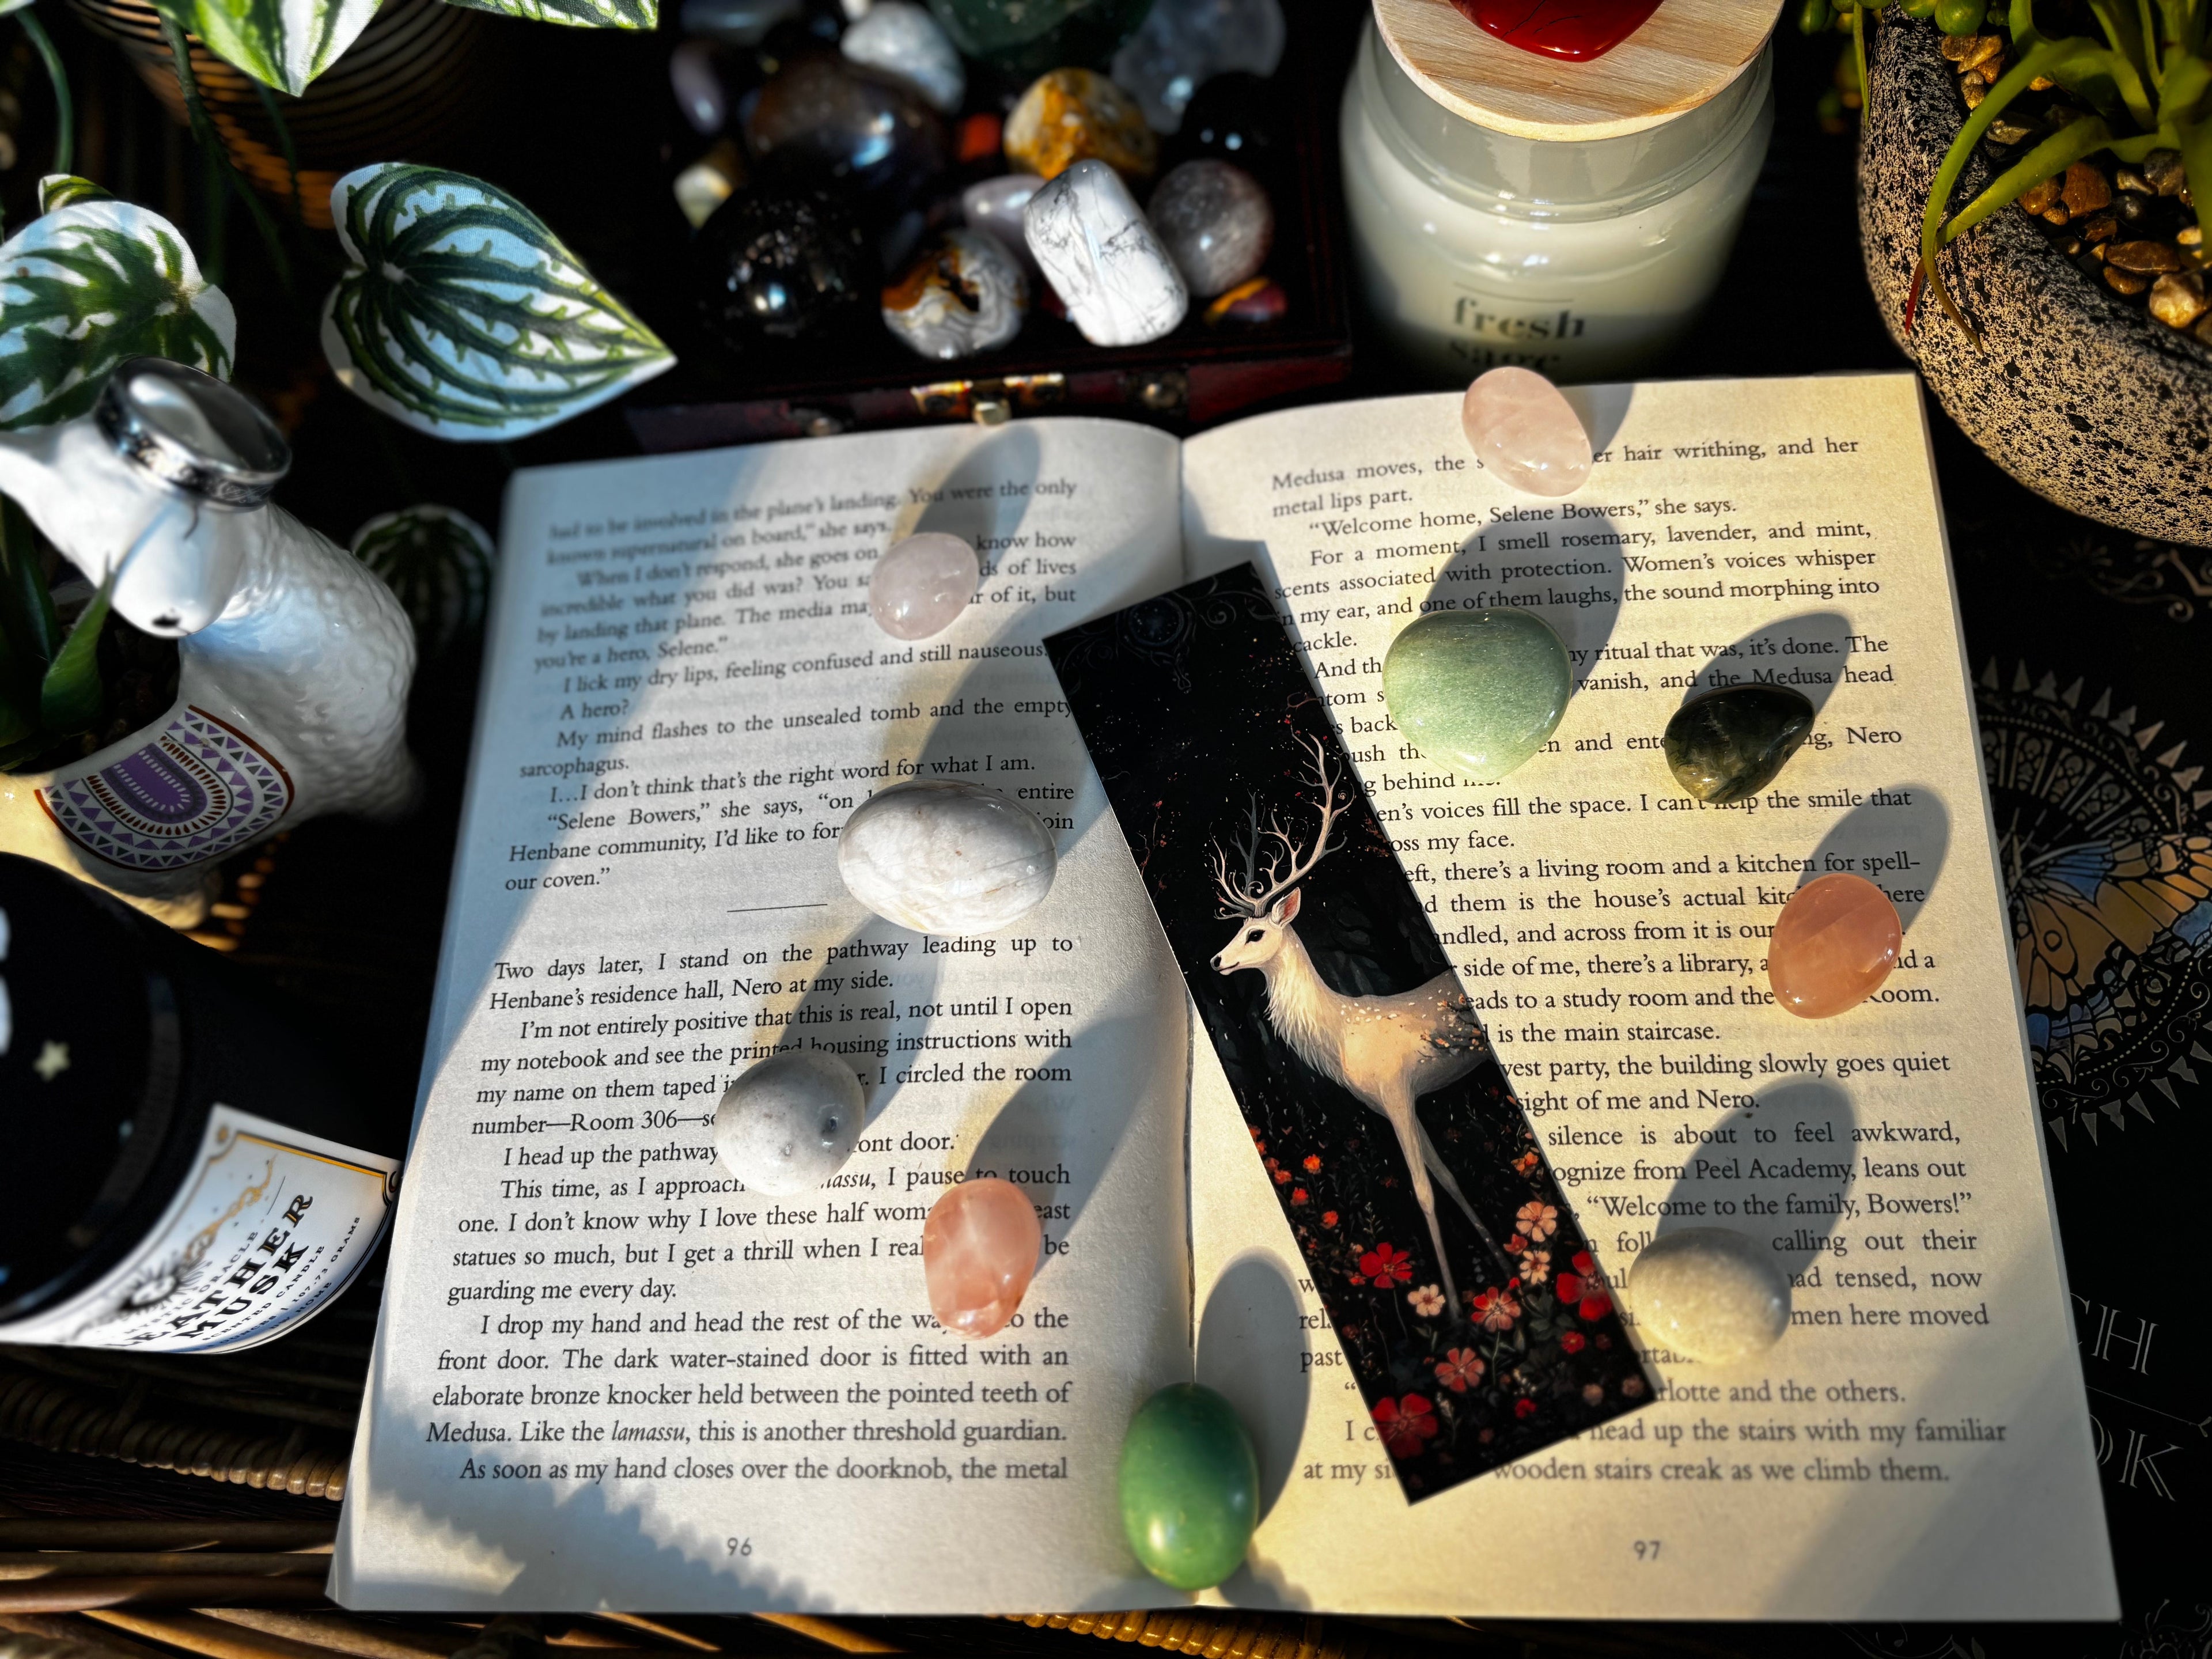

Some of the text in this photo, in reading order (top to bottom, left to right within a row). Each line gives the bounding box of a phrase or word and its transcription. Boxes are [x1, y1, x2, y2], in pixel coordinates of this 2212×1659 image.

[1455, 297, 1585, 339] fresh
[1272, 489, 1413, 518] metal lips part.
[1309, 497, 1737, 537] “Welcome home, Selene Bowers,” she says.
[1310, 520, 1871, 566] For a moment, I smell rosemary, lavender, and mint,
[1275, 548, 1876, 600] scents associated with protection. Women’s voices whisper
[564, 643, 1048, 694] I lick my dry lips, feeling confused and still nauseous.
[557, 697, 1071, 747] My mind flashes to the unsealed tomb and the empty
[520, 756, 629, 780] sarcophagus.
[594, 780, 640, 800] don’t
[646, 775, 694, 796] think
[701, 771, 746, 791] that’s
[753, 769, 782, 787] the
[788, 764, 835, 788] right
[840, 759, 890, 780] word
[896, 758, 925, 776] for
[930, 755, 979, 774] what
[985, 755, 993, 771] I
[1000, 758, 1035, 771] am.
[505, 867, 611, 891] our coven.”
[1404, 850, 1921, 885] eft, there’s a living room and a kitchen for spell-
[495, 935, 1073, 981] Two days later, I stand on the pathway leading up to
[489, 969, 893, 1010] Henbane’s residence hall, Nero at my side.
[1497, 1021, 1720, 1043] is the main staircase.
[1500, 1051, 1951, 1082] vest party, the building slowly goes quiet
[1517, 1088, 1760, 1116] sight of me and Nero.
[1548, 1120, 1960, 1146] silence is about to feel awkward,
[1586, 1192, 1972, 1221] “Welcome to the family, Bowers!”
[331, 1216, 361, 1263] GRAMS
[98, 1194, 313, 1347] LEATHER
[199, 1232, 258, 1293] ORACLE
[171, 1241, 309, 1339] MUSK
[202, 1245, 324, 1341] SCENTED CANDLE
[447, 1277, 676, 1306] guarding me every day.
[437, 1343, 1069, 1370] front door. The dark water-stained door is fitted with an
[425, 1418, 1067, 1448] Medusa. Like the lamassu, this is another threshold guardian.
[1654, 1425, 1683, 1448] up
[1692, 1417, 1729, 1441] the
[1738, 1419, 1797, 1441] stairs
[1804, 1417, 1861, 1441] with
[1869, 1426, 1906, 1448] my
[1915, 1417, 2006, 1442] familiar
[1494, 1456, 1950, 1482] wooden stairs creak as we climb them.
[727, 1537, 752, 1557] 96
[1633, 1540, 1661, 1560] 97
